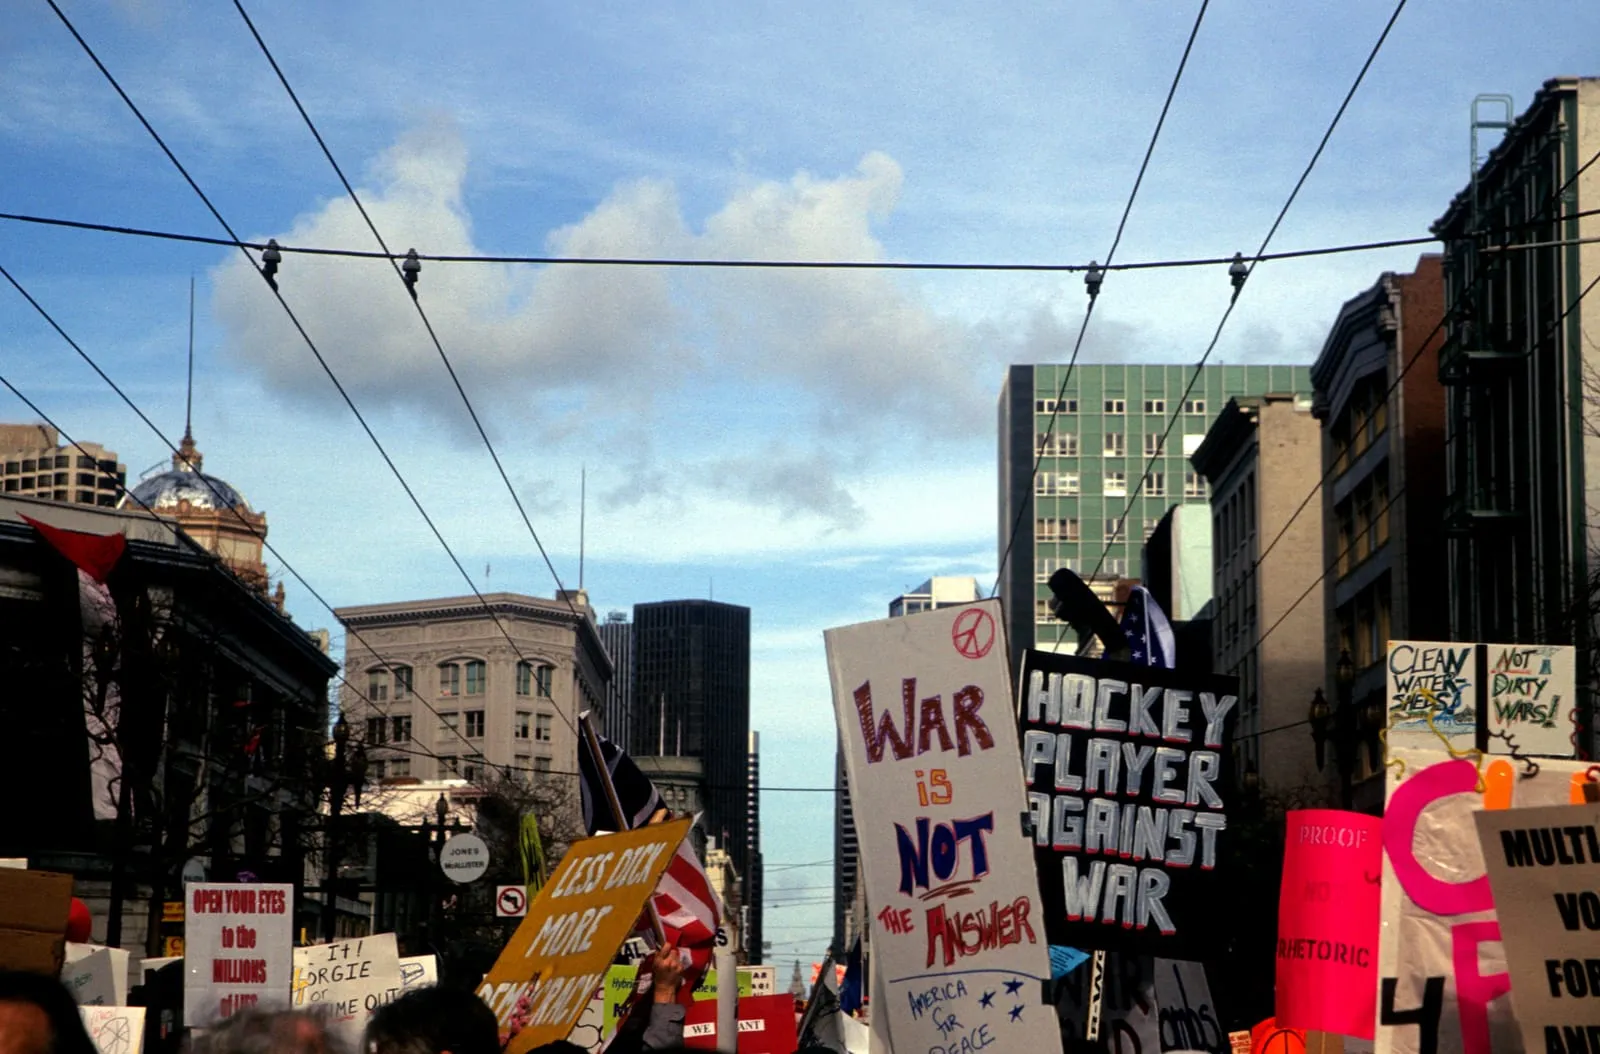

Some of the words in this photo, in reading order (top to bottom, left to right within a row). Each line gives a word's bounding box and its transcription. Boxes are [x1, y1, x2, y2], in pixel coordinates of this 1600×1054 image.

[1389, 645, 1472, 675] CLEAN
[1495, 648, 1537, 671] NOT
[1493, 674, 1548, 699] DIRTY
[853, 677, 996, 764] WAR
[1027, 669, 1238, 748] HOCKEY
[1494, 694, 1561, 729] WARS!
[1023, 729, 1224, 809] PLAYER
[1028, 791, 1227, 871] AGAINST
[1300, 825, 1368, 849] PROOF
[551, 851, 615, 898] LESS
[603, 841, 667, 891] DICK
[893, 810, 994, 898] NOT
[193, 889, 222, 913] OPEN
[225, 889, 256, 913] YOUR
[258, 890, 285, 914] EYES
[1062, 855, 1177, 936] WAR
[1304, 879, 1341, 903] NO
[222, 926, 233, 948] to
[236, 925, 256, 949] the
[524, 905, 613, 958] MORE
[877, 905, 915, 935] THE
[925, 895, 1037, 969] ANSWER
[1277, 937, 1370, 968] RHETORIC
[213, 959, 267, 983] MILLIONS
[307, 961, 371, 986] ORGIE
[907, 980, 968, 1021] AMERICA
[692, 1024, 711, 1034] WE
[739, 1020, 760, 1031] ANT
[928, 1023, 996, 1054] EACE
